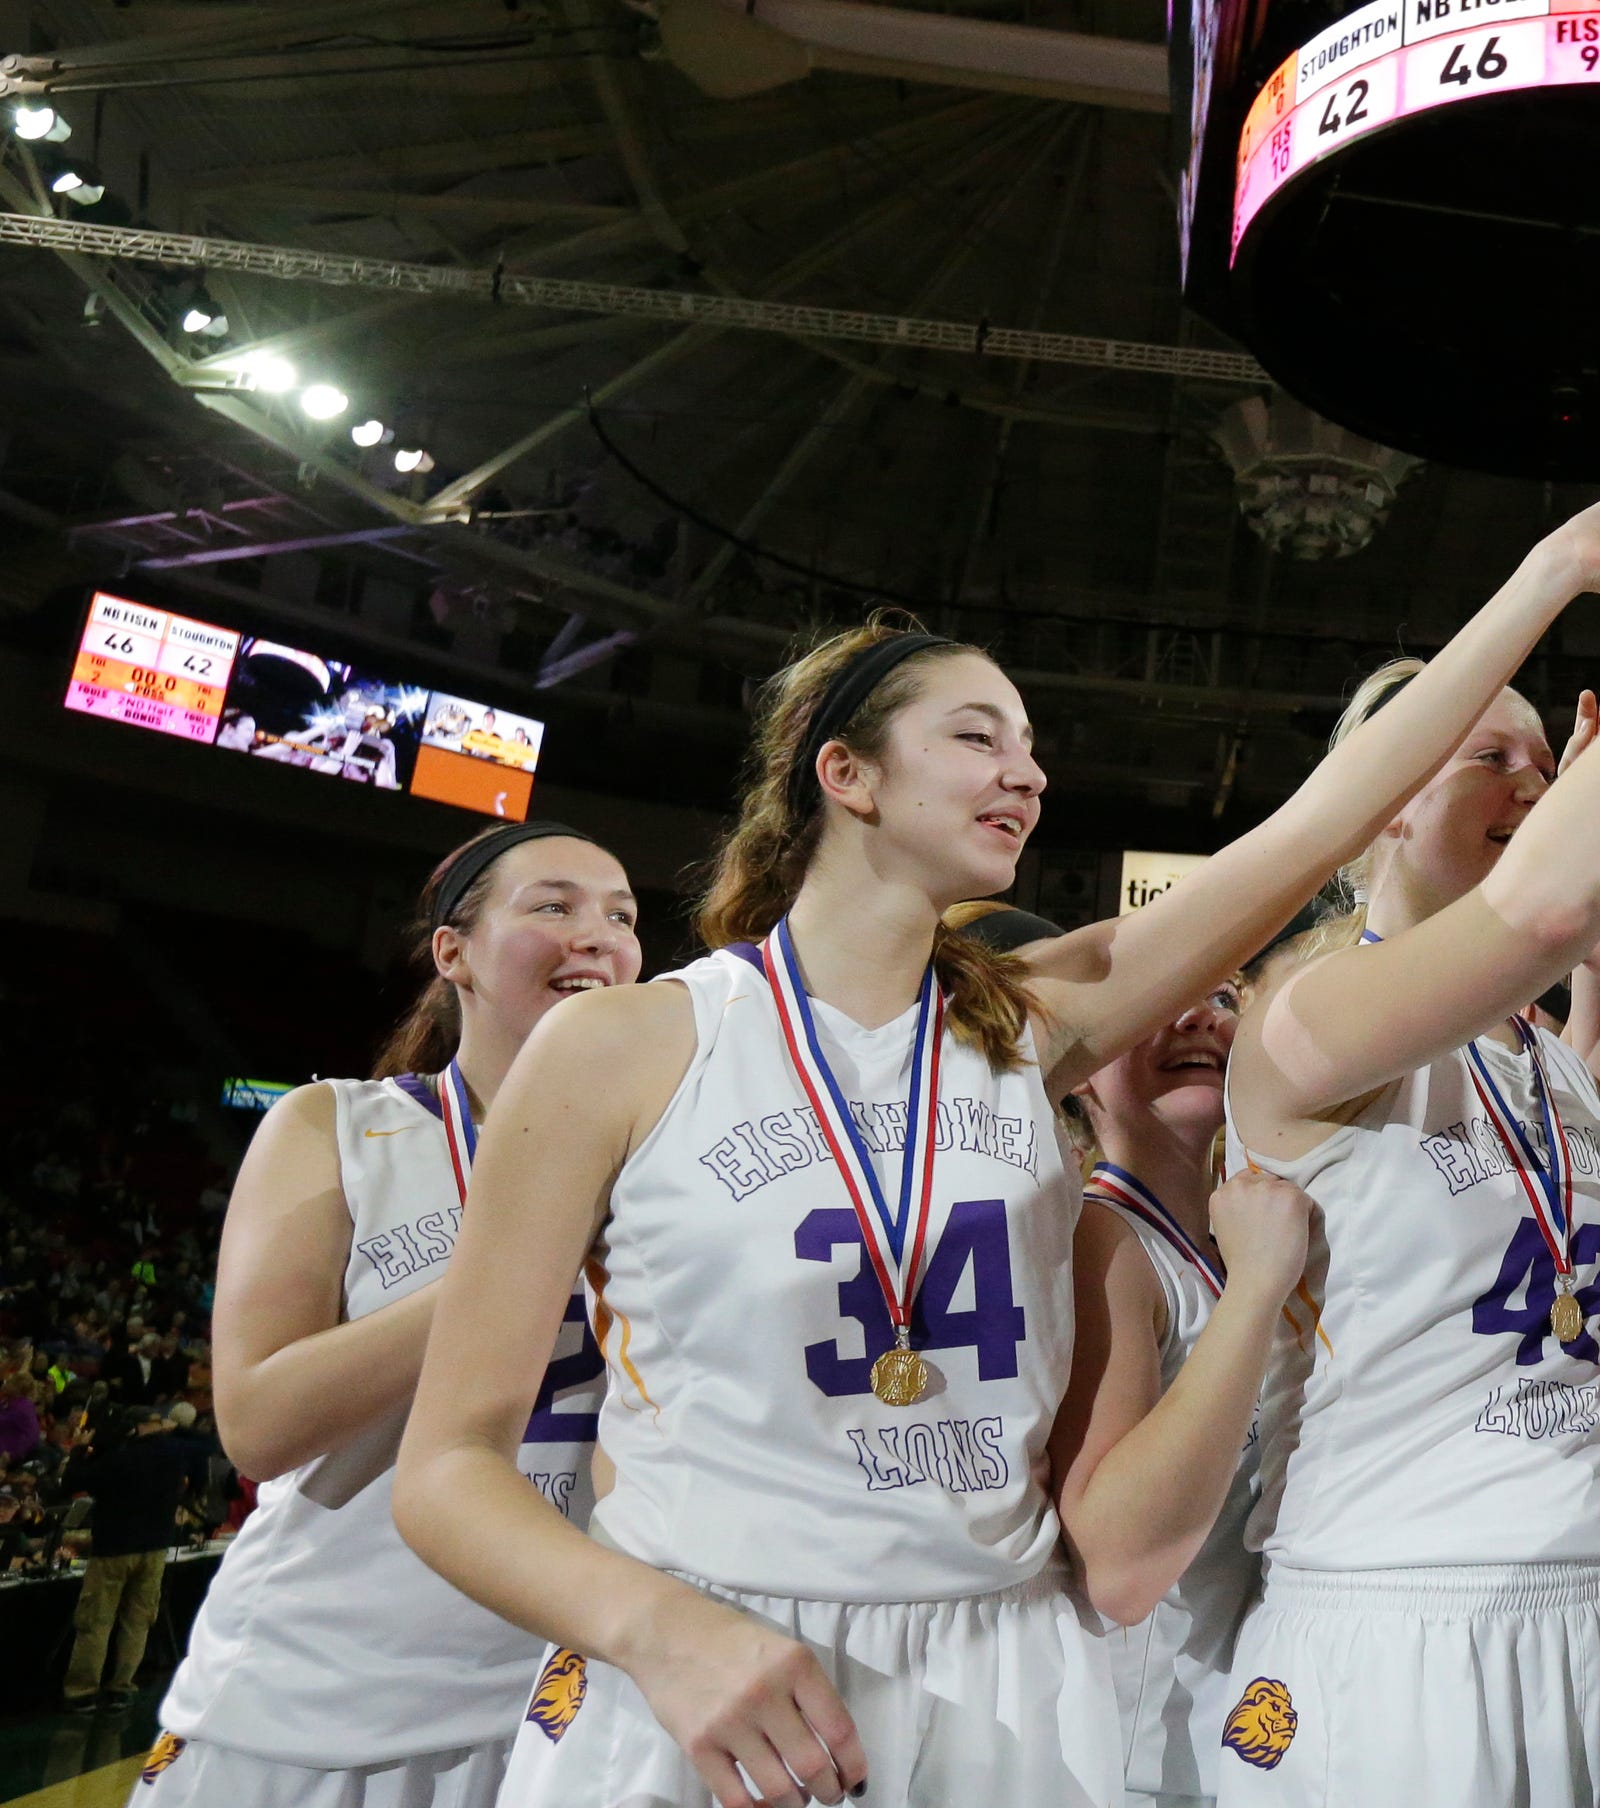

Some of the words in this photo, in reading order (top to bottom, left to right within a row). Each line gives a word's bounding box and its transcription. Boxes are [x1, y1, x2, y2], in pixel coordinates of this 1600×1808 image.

[1557, 19, 1599, 44] FLS
[1300, 12, 1398, 83] STOUGHTON
[1439, 37, 1508, 85] 46
[1580, 45, 1600, 72] 9
[1318, 79, 1369, 137] 42
[1271, 120, 1291, 156] FLS
[1272, 147, 1290, 180] 10
[103, 605, 121, 620] NB
[123, 611, 158, 630] EISEN
[104, 633, 133, 654] 46
[171, 625, 234, 651] STOUGHTON
[131, 667, 176, 692] 00.0
[183, 655, 212, 676] 42
[794, 1199, 1026, 1397] 34
[846, 1416, 1009, 1493] LIONS
